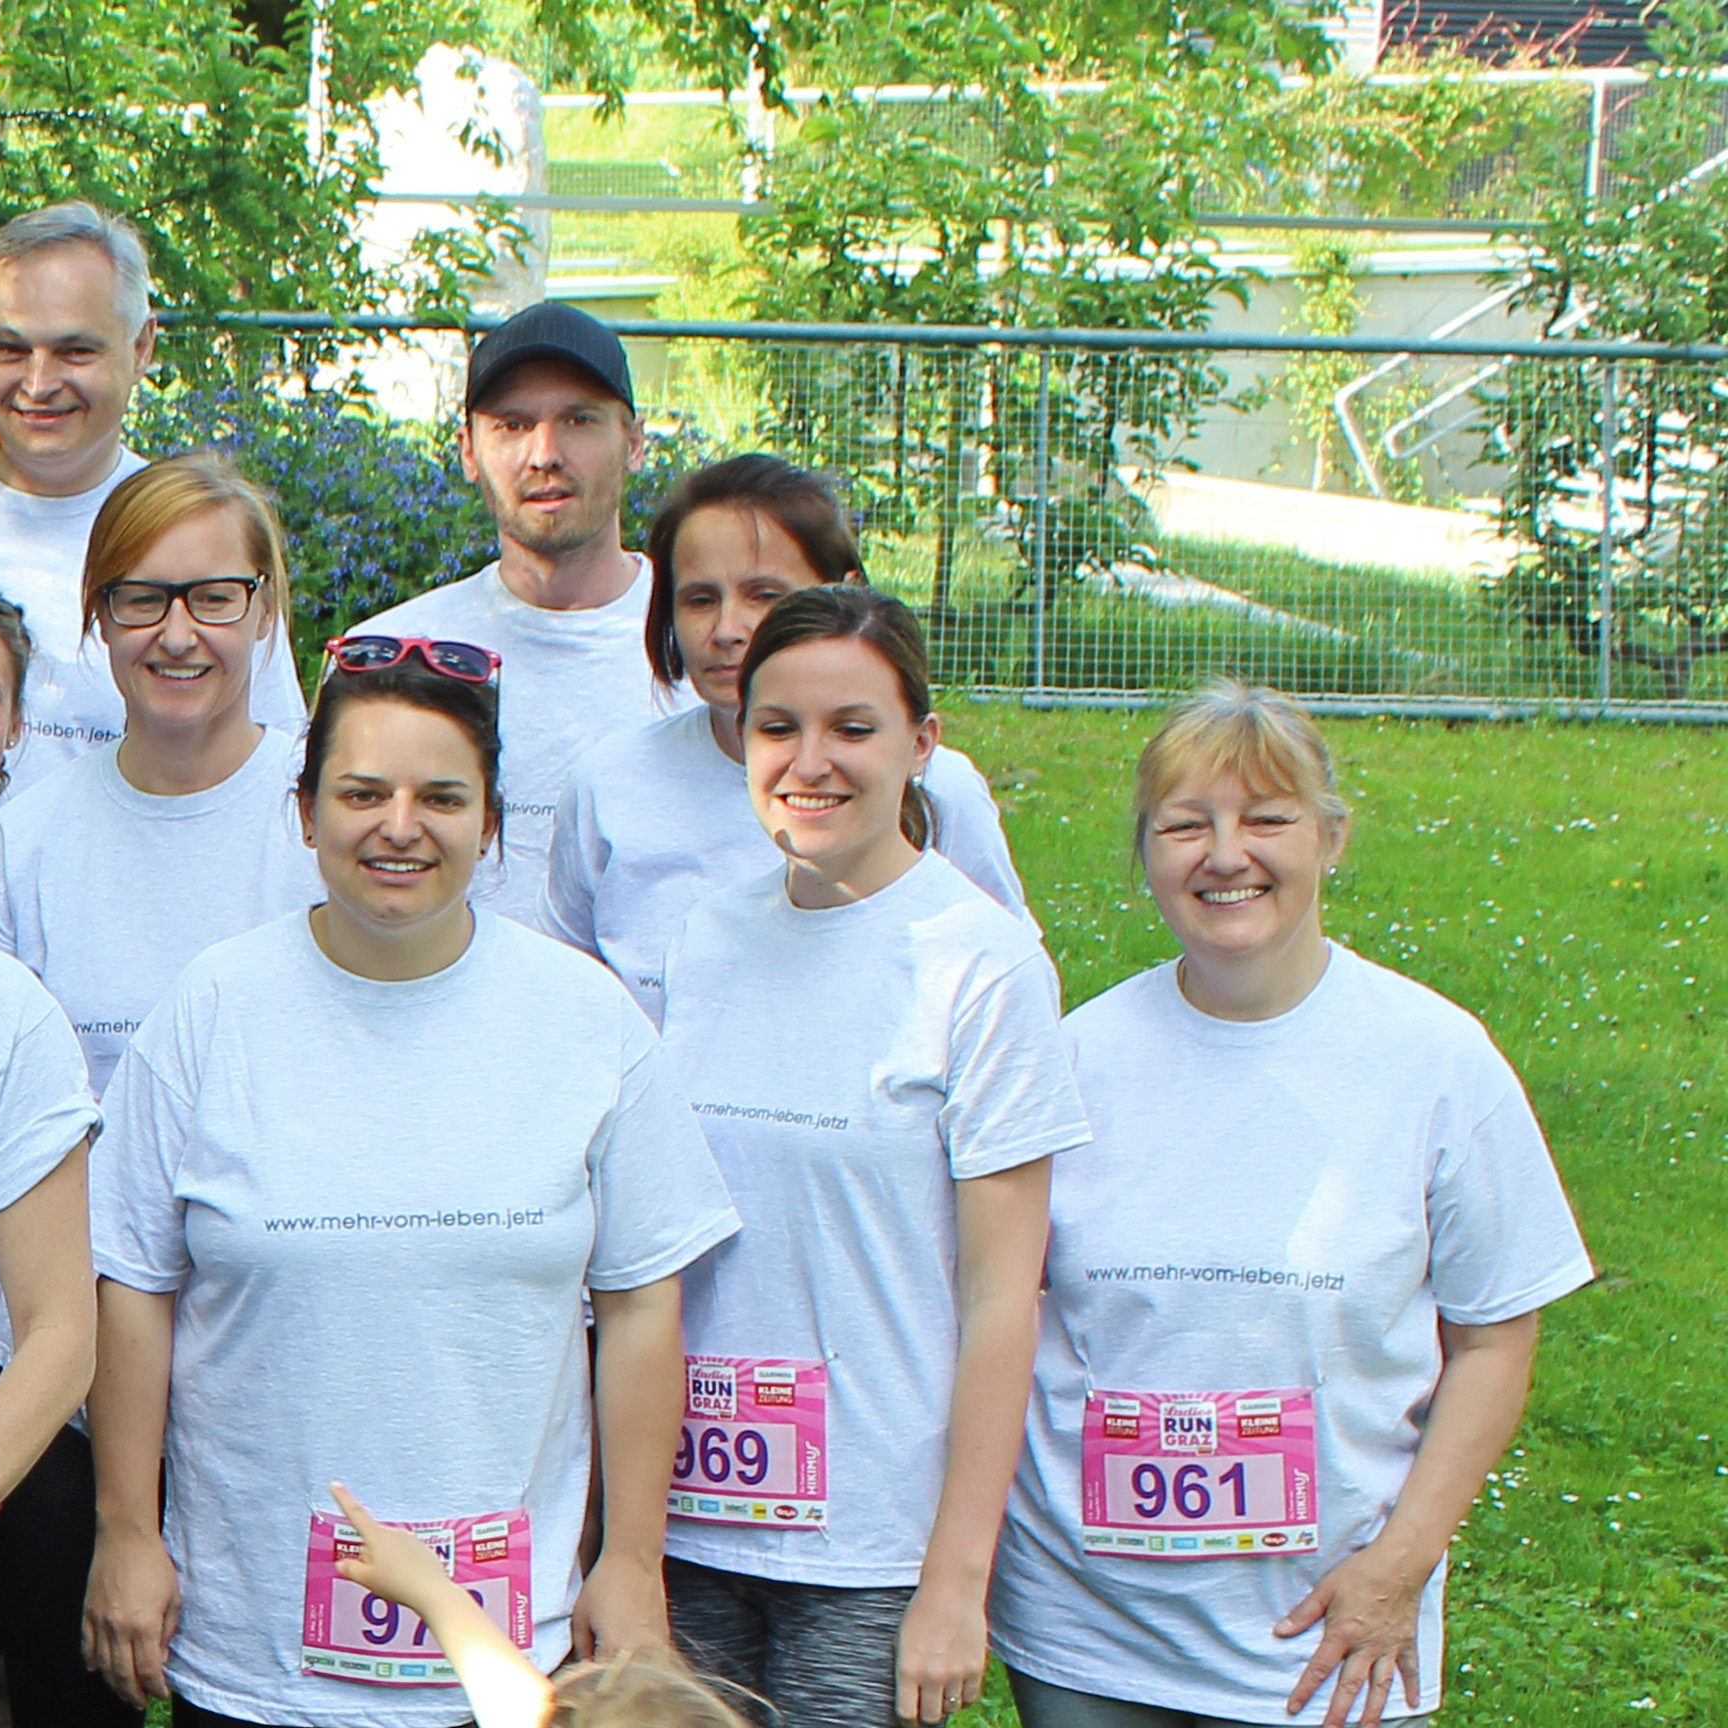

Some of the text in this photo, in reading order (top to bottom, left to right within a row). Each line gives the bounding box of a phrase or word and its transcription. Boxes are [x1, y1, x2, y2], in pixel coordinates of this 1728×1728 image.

[264, 1209, 544, 1232] www.mehr-vom-leben.jetzt
[1085, 1264, 1344, 1291] www.mehr-vom-leben.jetzt
[692, 1380, 732, 1397] RUN
[758, 1387, 793, 1396] KLEINE
[693, 1397, 732, 1410] GRAZ
[758, 1394, 793, 1404] ZEITUNG
[1107, 1418, 1137, 1427] KLEINE
[1164, 1418, 1212, 1432] RUN
[1241, 1417, 1279, 1427] KLEINE
[1164, 1434, 1212, 1446] GRAZ
[673, 1426, 768, 1486] 969
[805, 1441, 821, 1495] HIKIMUS
[1131, 1462, 1247, 1519] 961
[1296, 1468, 1310, 1521] HIKIMUS
[475, 1540, 507, 1552] KLEINE
[517, 1591, 528, 1644] HIKIMUS
